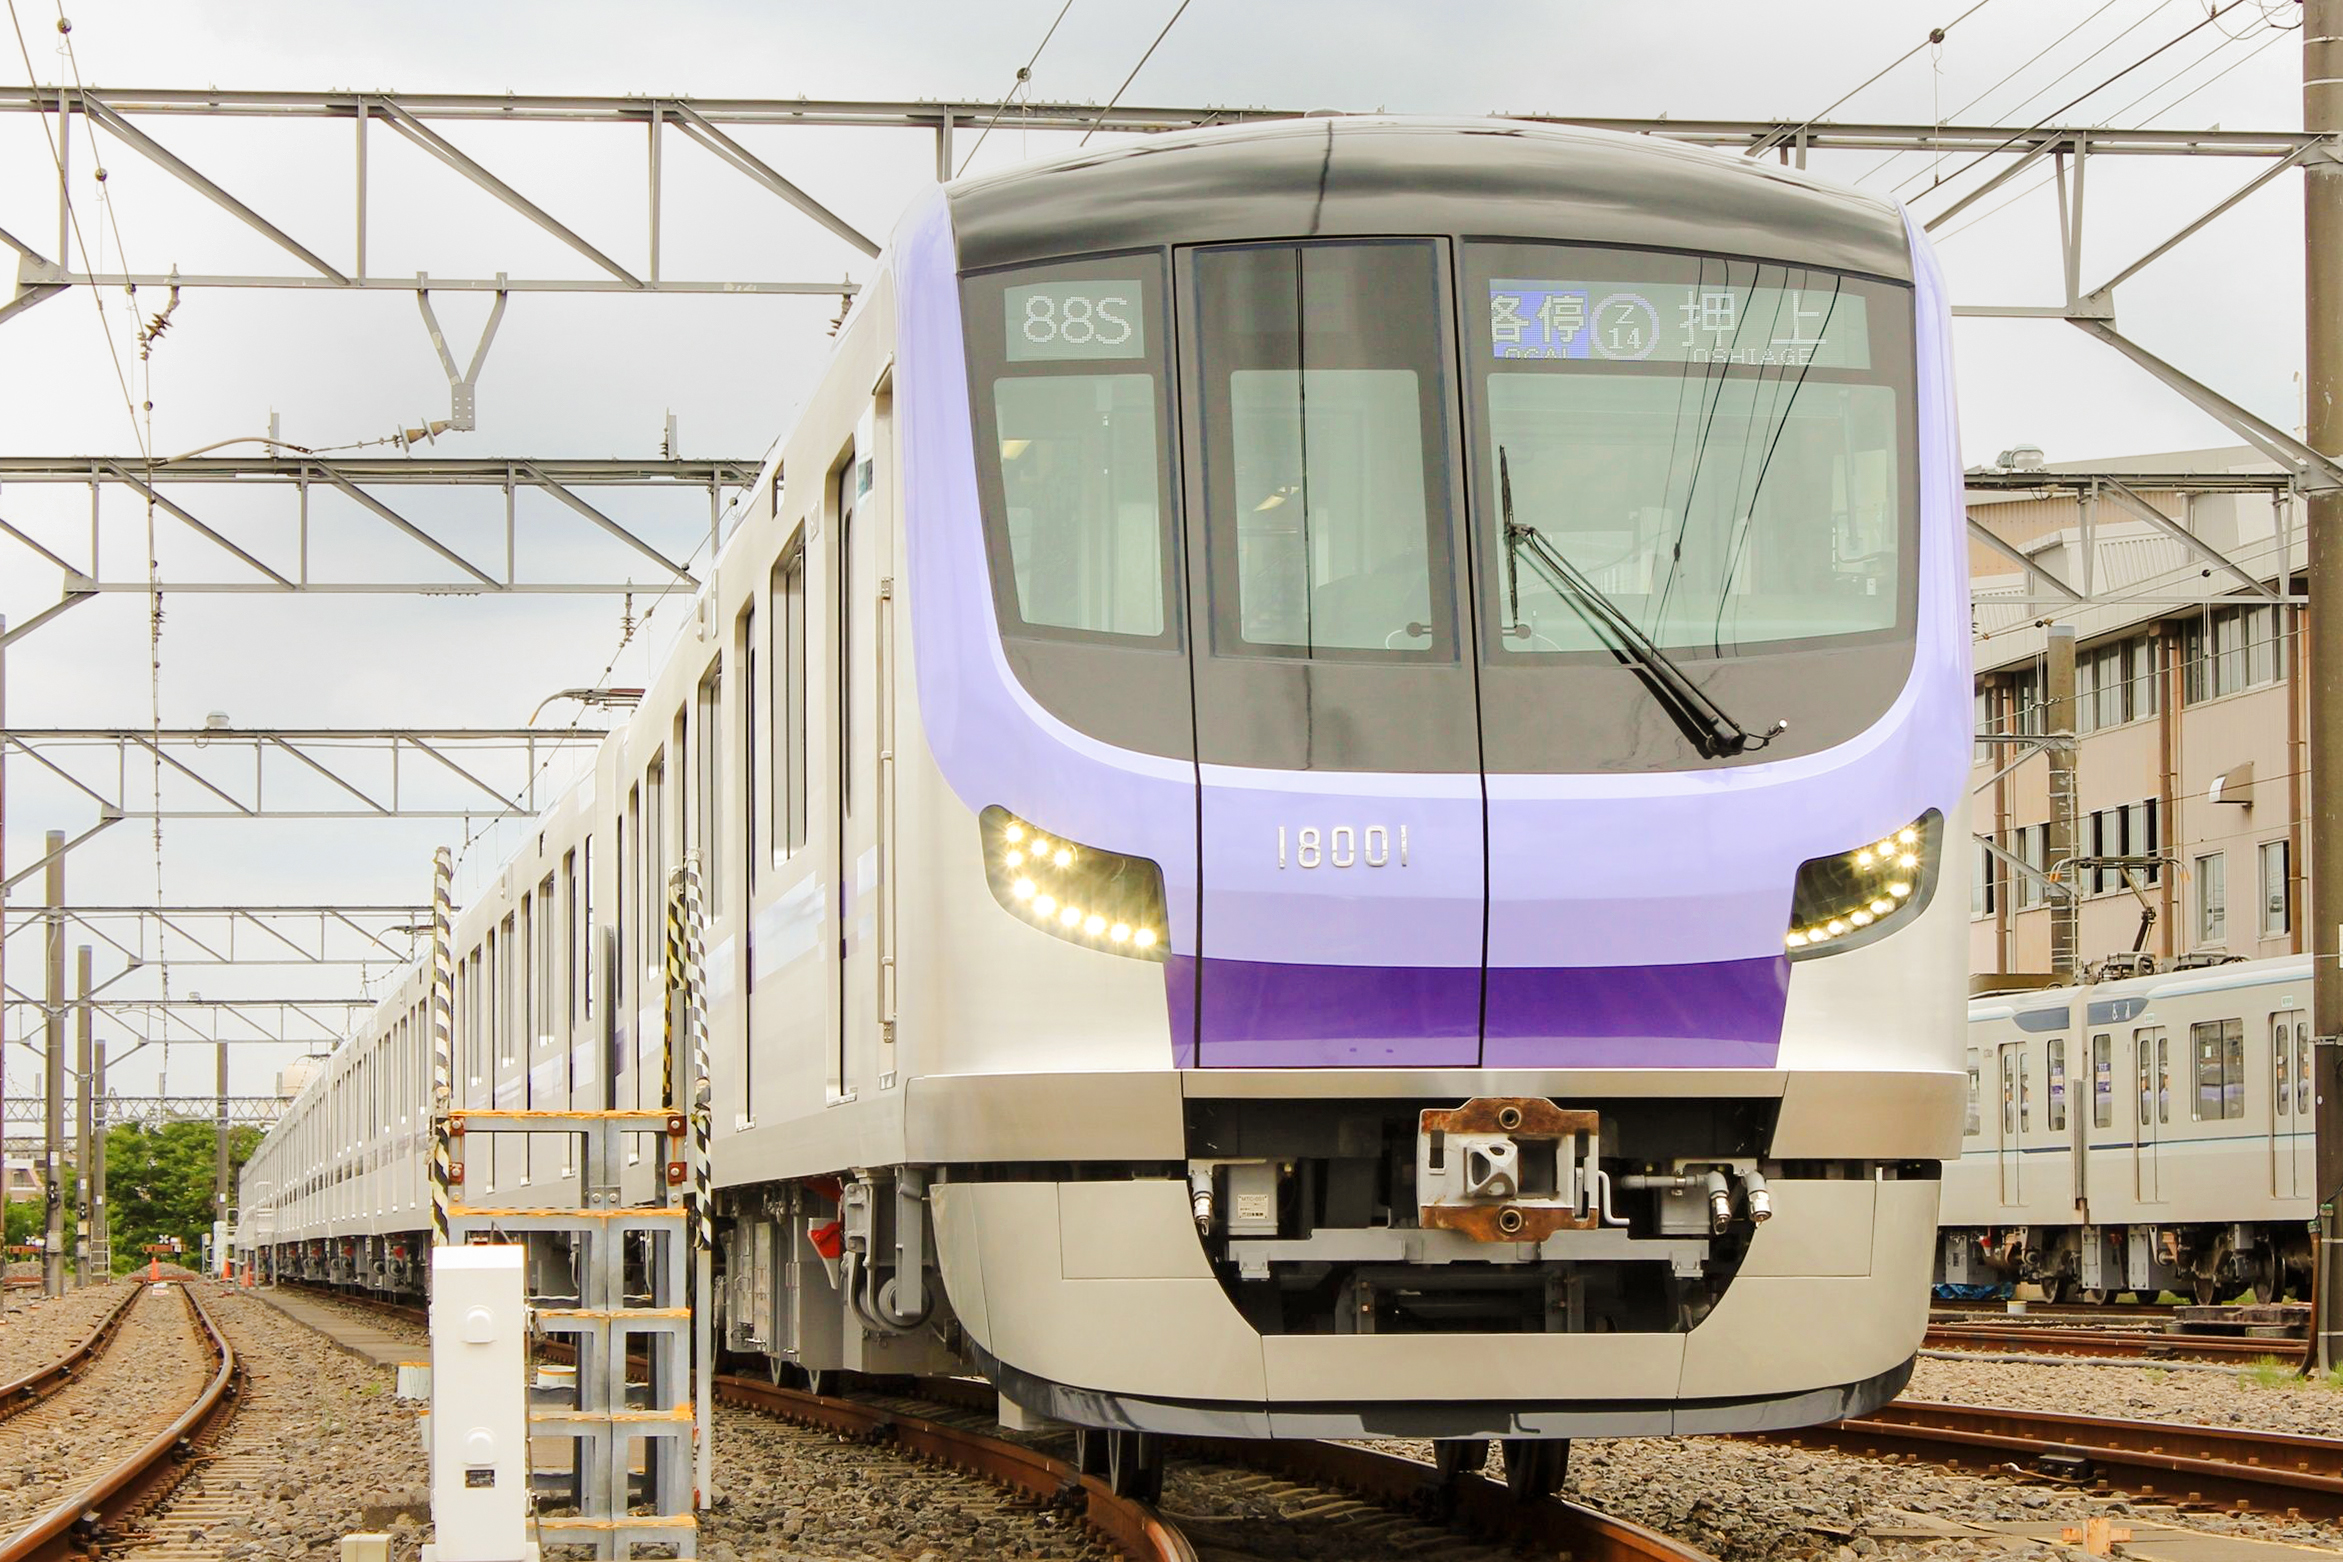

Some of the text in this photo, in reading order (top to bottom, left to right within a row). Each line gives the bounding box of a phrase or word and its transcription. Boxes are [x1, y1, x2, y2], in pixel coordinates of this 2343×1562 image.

[1023, 295, 1132, 345] 88S
[1490, 295, 1584, 343] 各停
[1614, 304, 1635, 325] Z
[1679, 291, 1827, 346] 押上
[1608, 327, 1642, 349] 14
[1693, 348, 1813, 366] OSHIAGE
[1278, 824, 1407, 869] 18001
